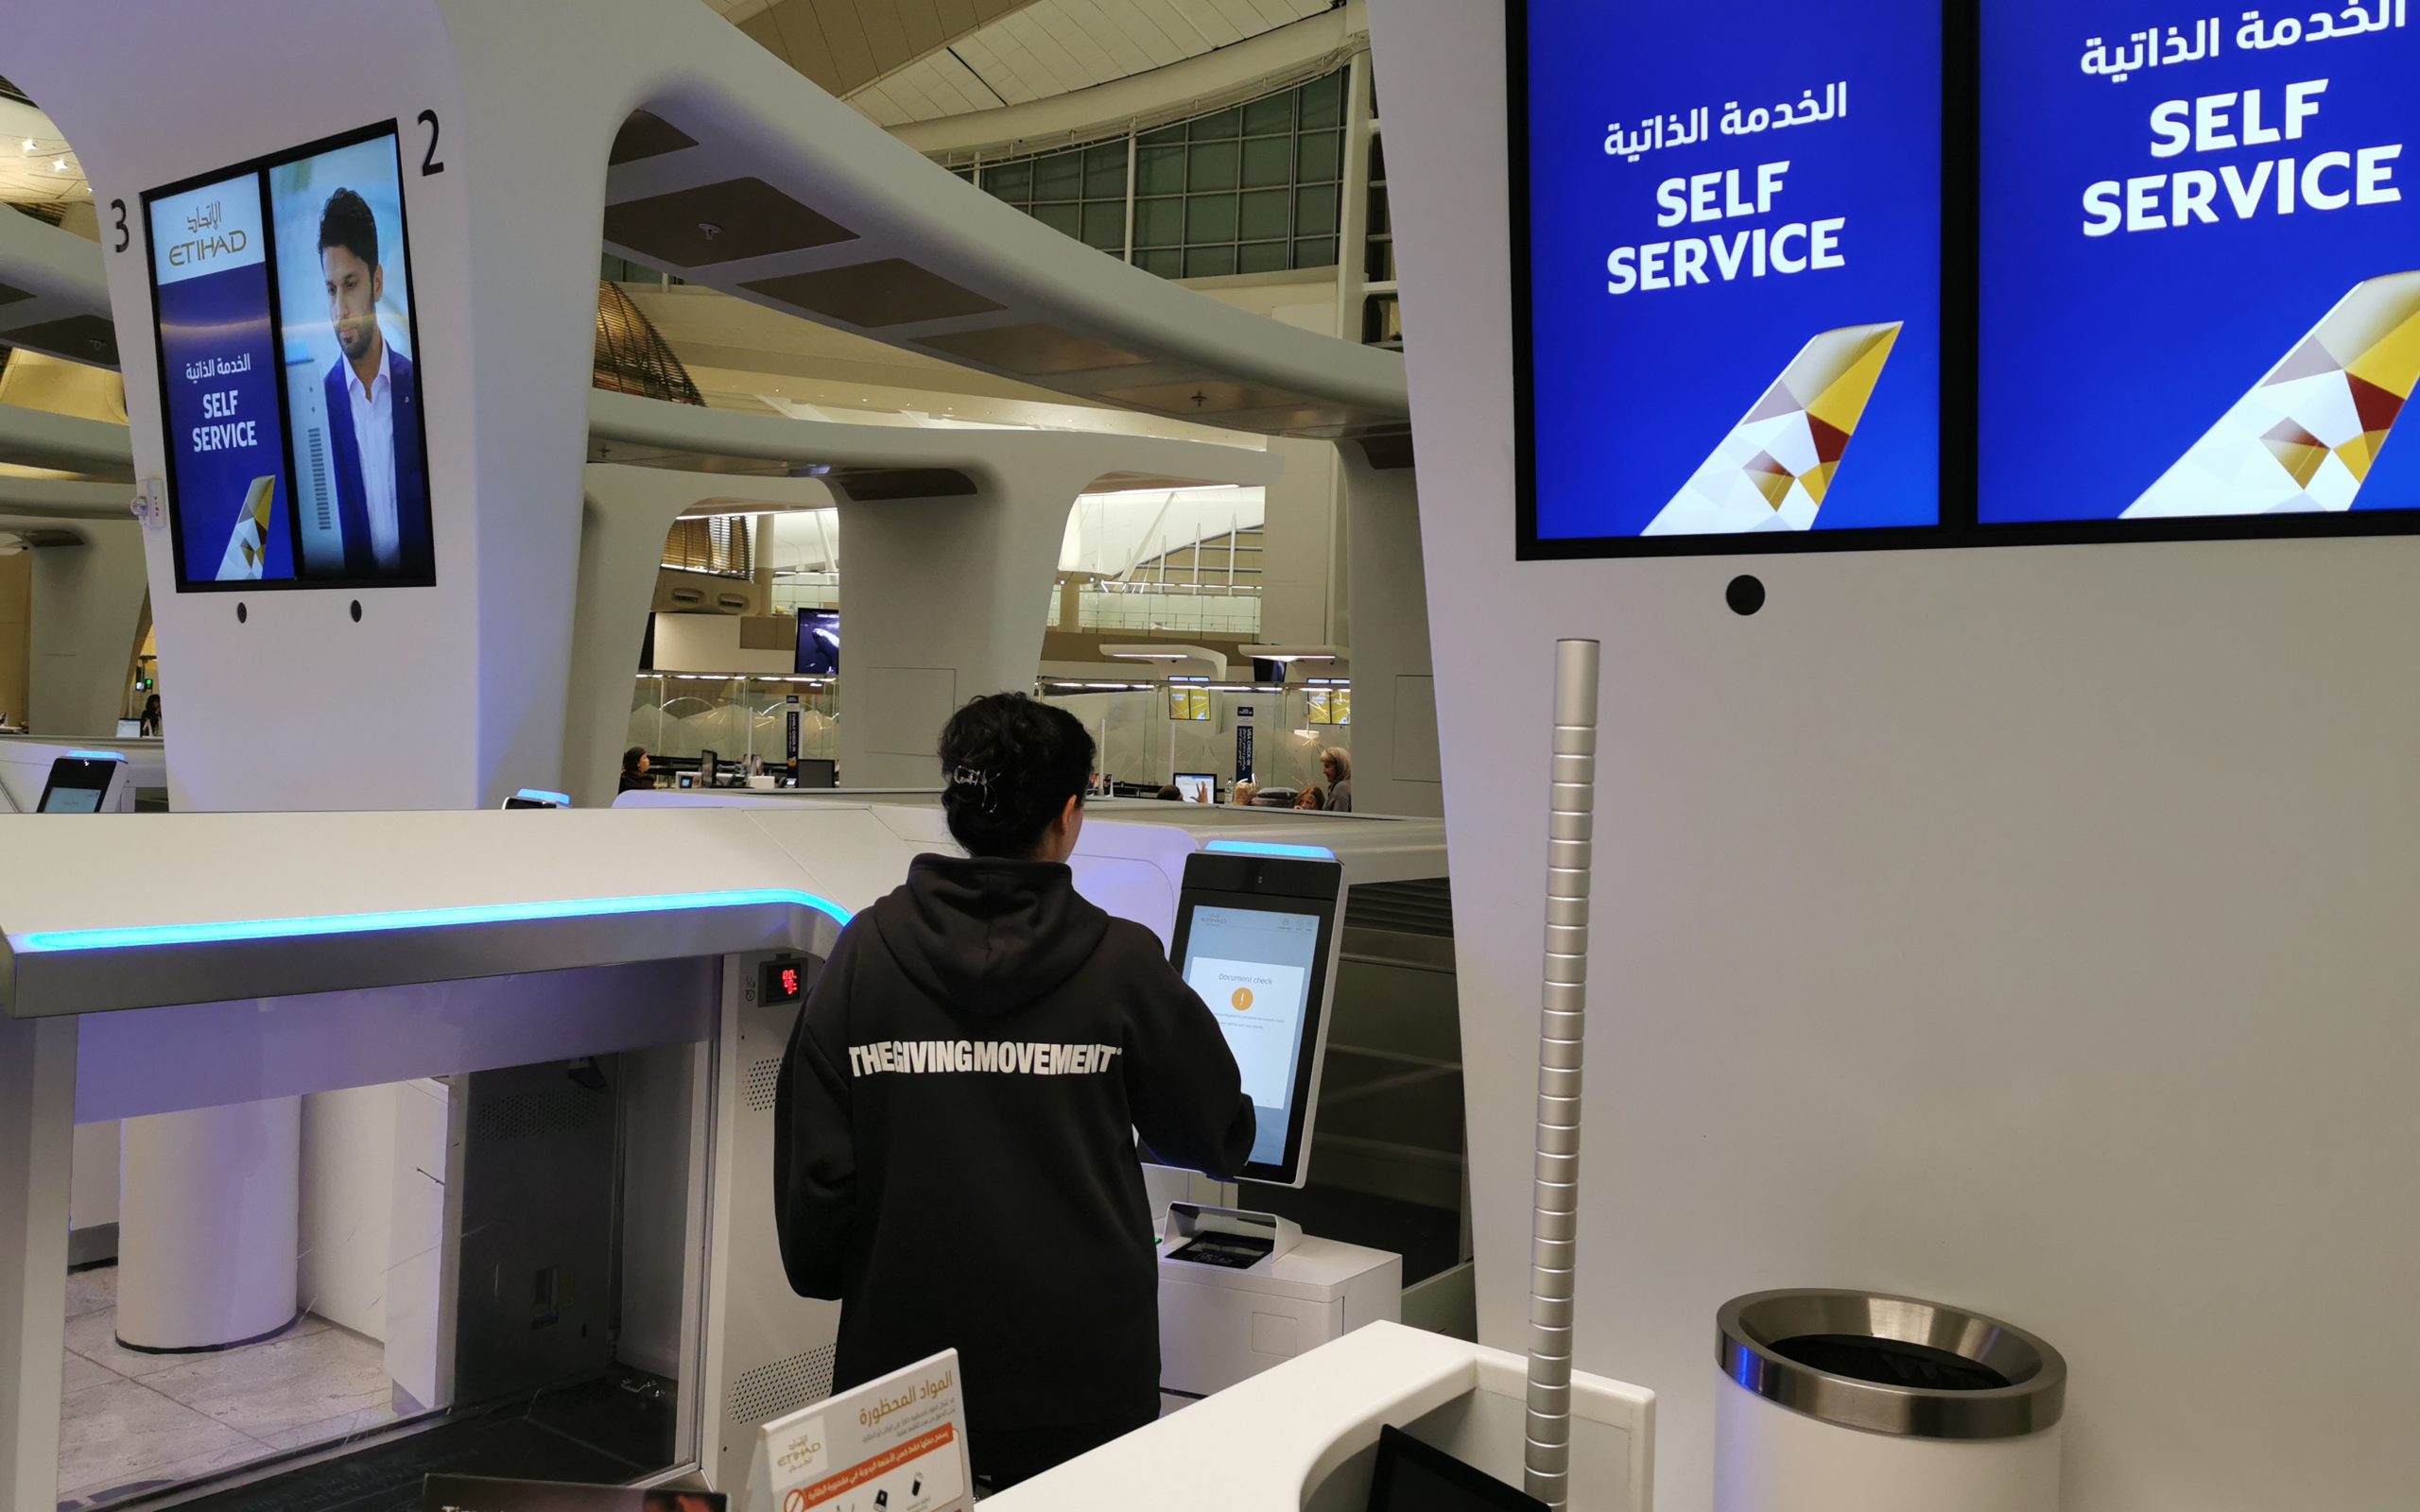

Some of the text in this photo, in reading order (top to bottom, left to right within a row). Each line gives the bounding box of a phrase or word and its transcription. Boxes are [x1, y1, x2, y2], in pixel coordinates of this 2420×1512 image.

[2081, 0, 2406, 83] الخدمة الذاتية
[417, 109, 444, 177] 2
[1604, 80, 1847, 163] الخدمة الذاتية
[2150, 78, 2329, 159] SELF
[1656, 160, 1790, 228] SELF
[2083, 144, 2403, 237] SERVICE
[111, 198, 130, 253] 3
[169, 230, 247, 266] ETIHAD
[1607, 216, 1846, 295] SERVICE
[186, 352, 251, 384] الخدمة الذاتية
[202, 389, 238, 419] SELF
[192, 421, 257, 453] SERVICE
[1219, 973, 1273, 985] Document check
[859, 1384, 917, 1428] المحظورة
[920, 1369, 953, 1399] المواد
[777, 1442, 821, 1467] ETIHAD
